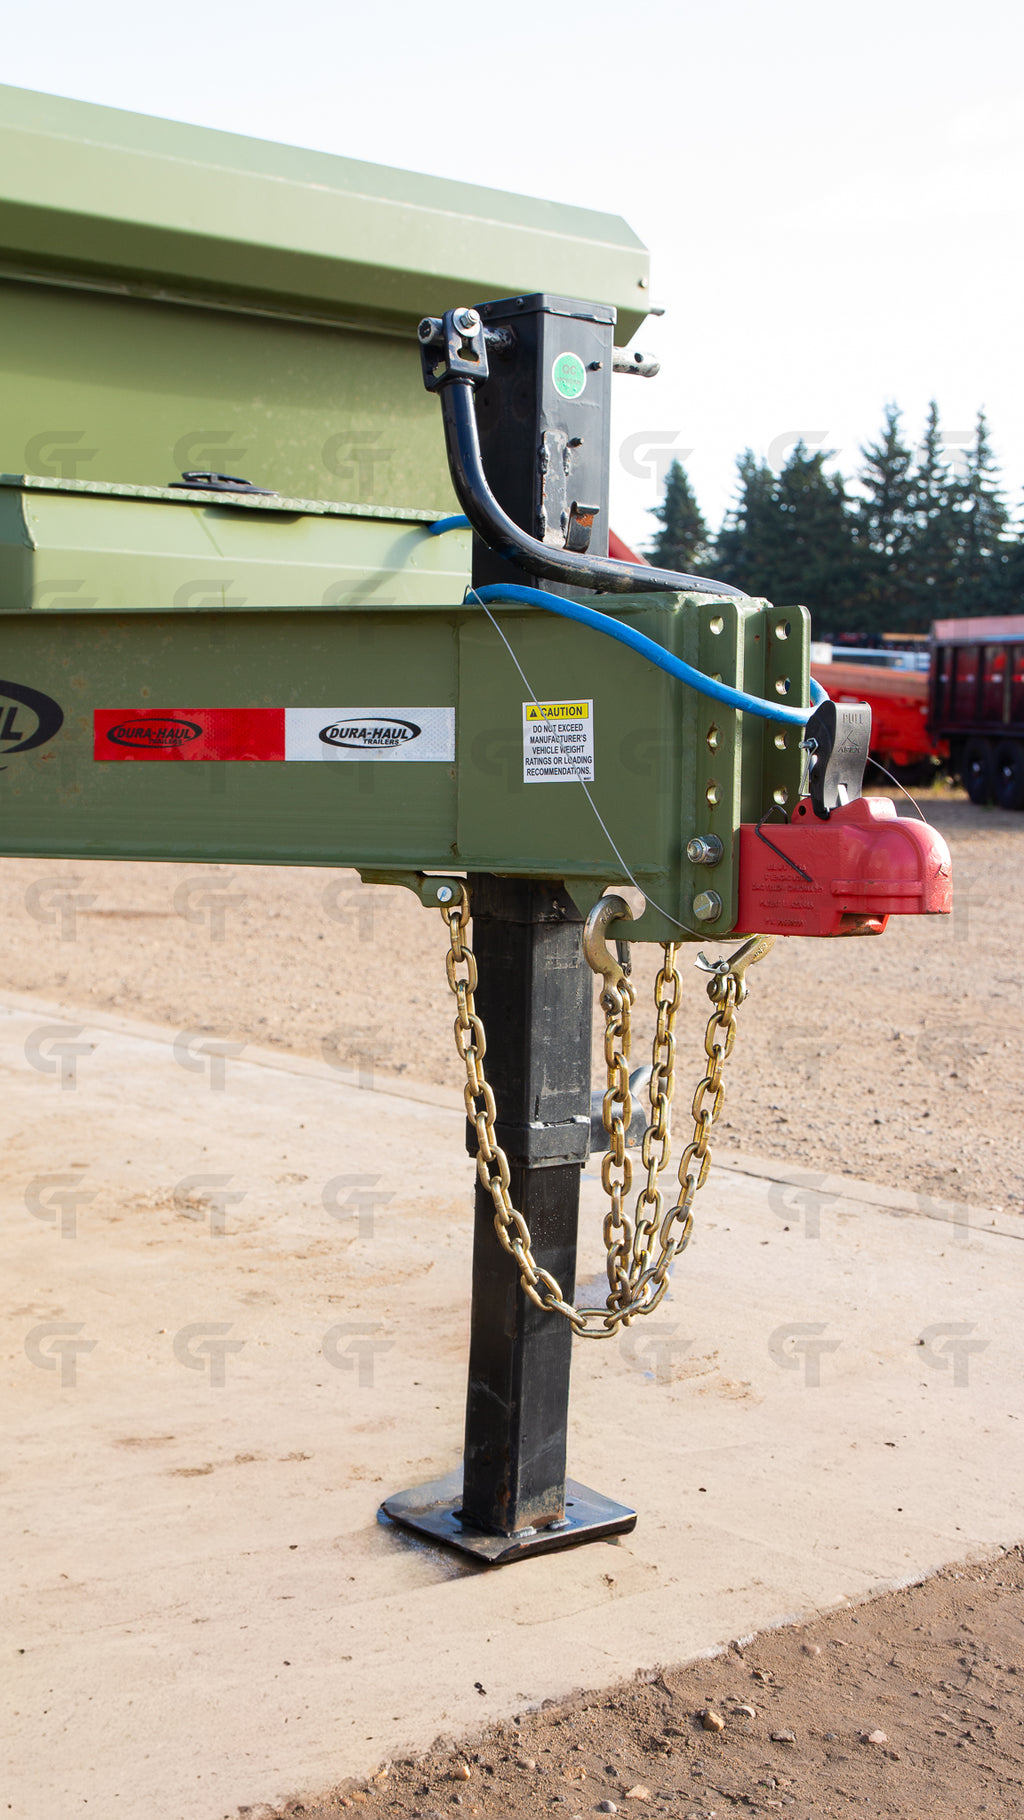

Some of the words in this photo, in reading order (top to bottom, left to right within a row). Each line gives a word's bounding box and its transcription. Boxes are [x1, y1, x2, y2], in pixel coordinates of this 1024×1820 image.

[541, 706, 583, 717] CAUTION
[842, 713, 864, 724] PULL
[533, 725, 542, 733] DO
[558, 724, 583, 732] EXCEED
[116, 728, 191, 739] DURA-HAUL
[330, 728, 409, 739] DURA-HAUL
[530, 734, 587, 743] MANUFACTURER'S
[532, 746, 558, 754] VEHICLE
[560, 745, 584, 754] WEIGHT
[525, 757, 552, 765] RATINGS
[564, 756, 592, 764] LOADING
[527, 767, 591, 776] RECOMMENDATIONS.
